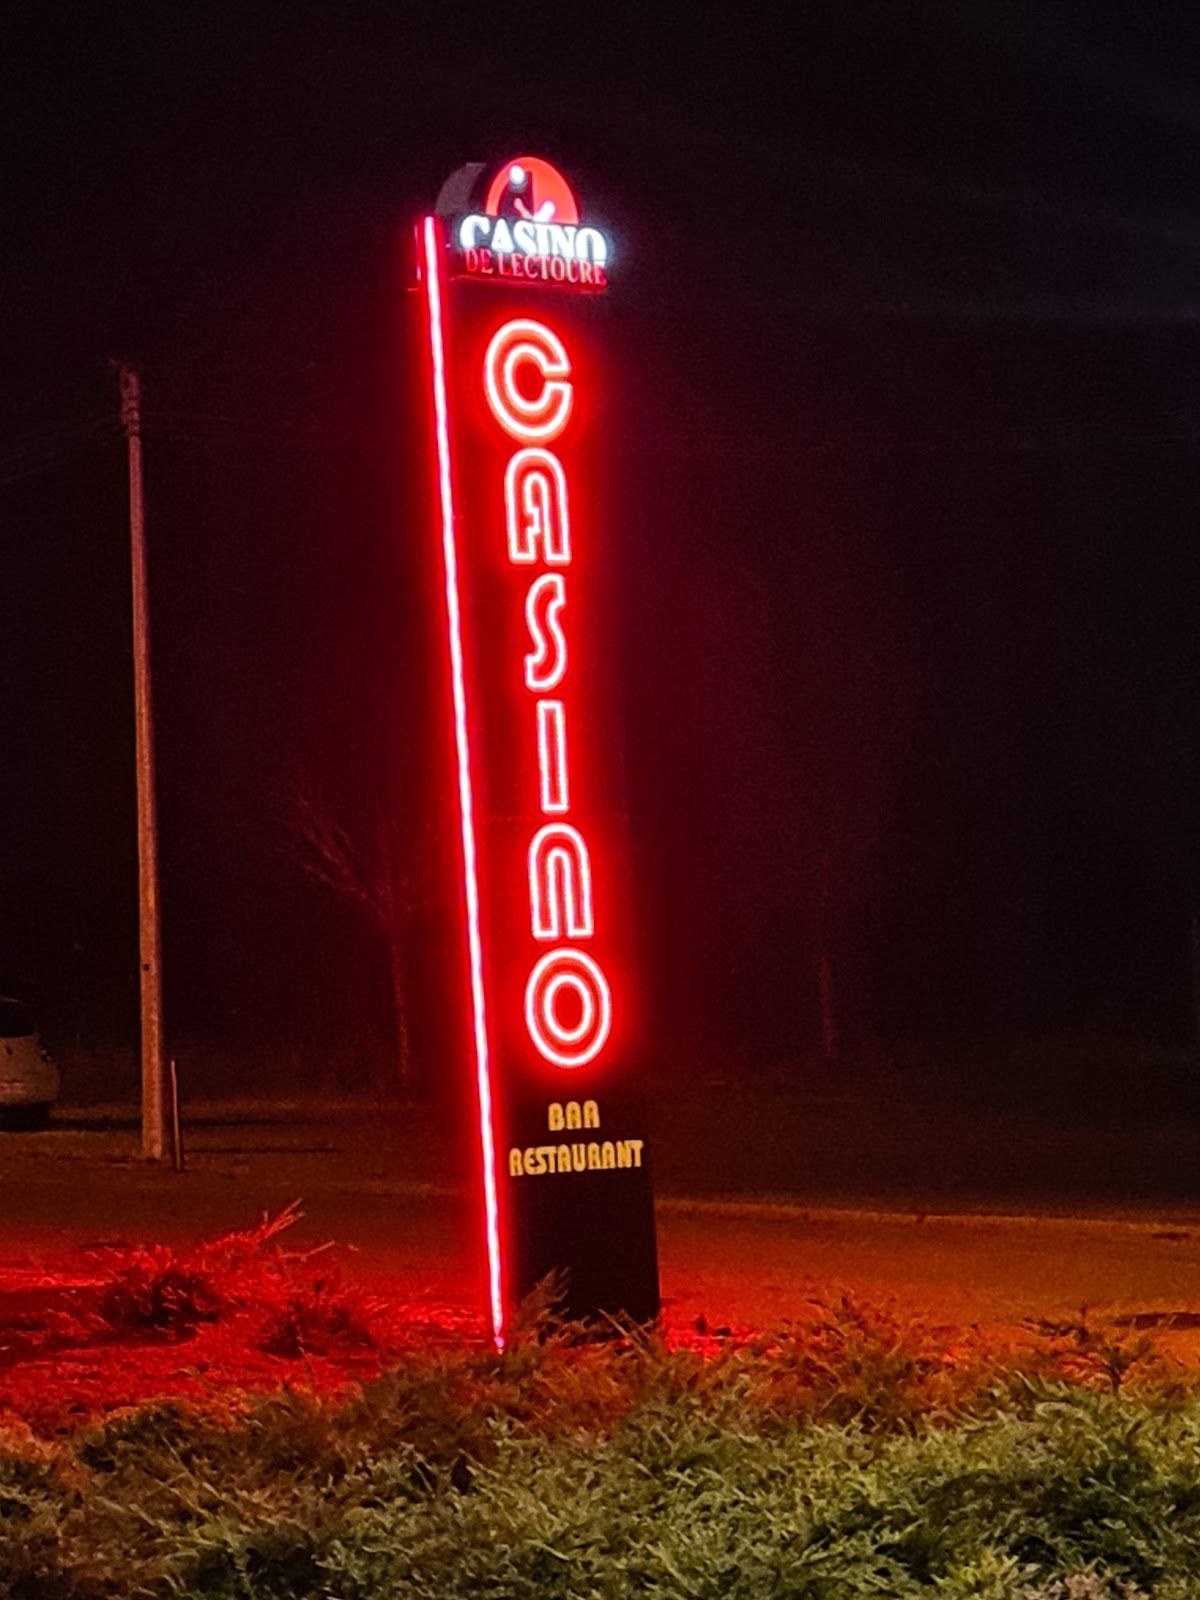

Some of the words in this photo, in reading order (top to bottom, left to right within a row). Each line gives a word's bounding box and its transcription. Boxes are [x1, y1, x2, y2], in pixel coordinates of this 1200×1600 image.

[459, 214, 608, 264] CASINO
[465, 248, 494, 274] DE
[498, 252, 608, 285] LECTOURE
[483, 318, 612, 1068] CASINO
[548, 1100, 600, 1131] BAR
[509, 1140, 644, 1177] RESTAURANT
